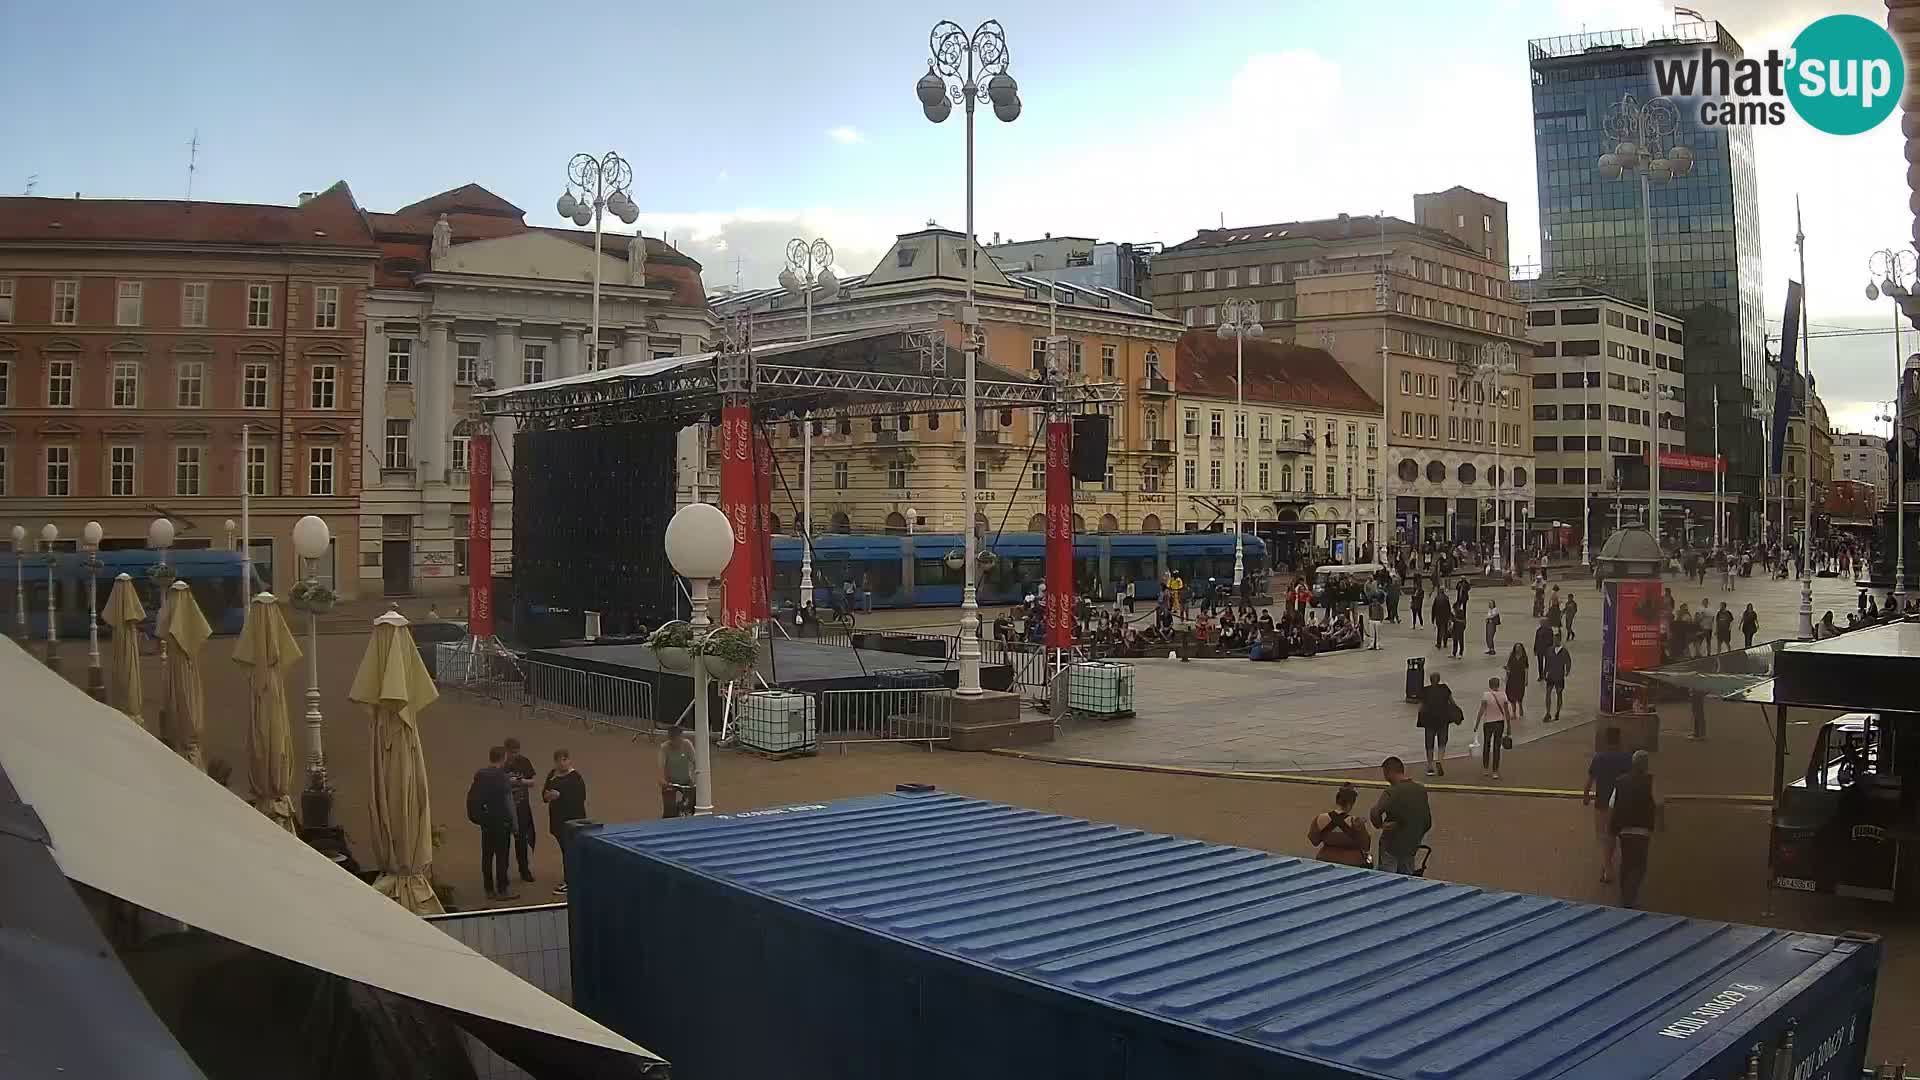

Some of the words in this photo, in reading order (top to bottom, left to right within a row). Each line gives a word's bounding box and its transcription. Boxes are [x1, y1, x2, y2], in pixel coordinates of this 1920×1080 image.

[735, 418, 748, 460] Coca-Cola
[735, 503, 747, 544] Coca-Cola
[1060, 592, 1070, 629] Coca-Cola
[1658, 1016, 1709, 1039] MCDU
[1693, 990, 1747, 1018] 300629
